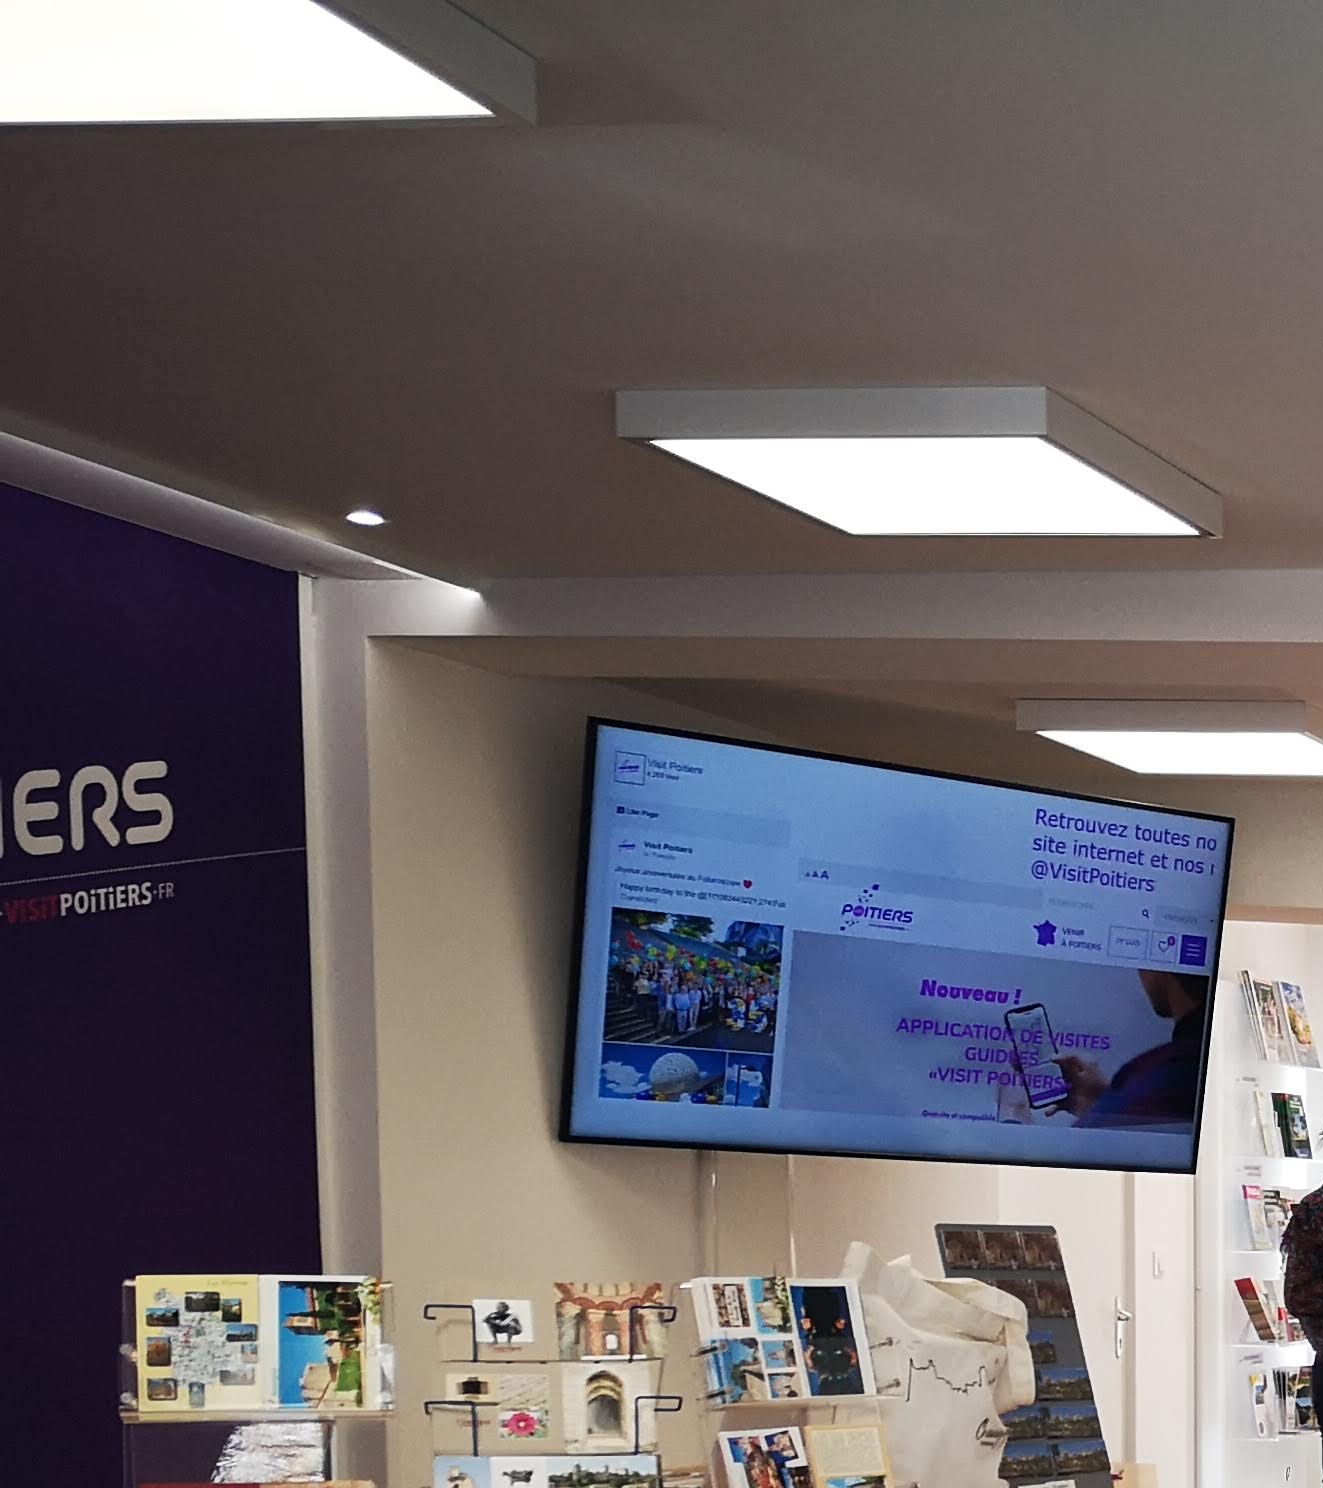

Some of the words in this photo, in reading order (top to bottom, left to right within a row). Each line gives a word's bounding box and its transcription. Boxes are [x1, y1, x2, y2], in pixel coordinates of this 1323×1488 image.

[1035, 808, 1128, 838] Retrouvez
[1135, 824, 1190, 848] toutes
[1032, 835, 1067, 855] site
[1073, 840, 1144, 866] internet
[1151, 853, 1168, 869] et
[1173, 857, 1204, 874] nos
[1031, 859, 1155, 892] @VisitPoitiers
[920, 979, 1009, 1004] Nouveau
[896, 1017, 1015, 1043] APPLICATION
[1020, 1028, 1043, 1045] DE
[1050, 1031, 1110, 1050] VISITES
